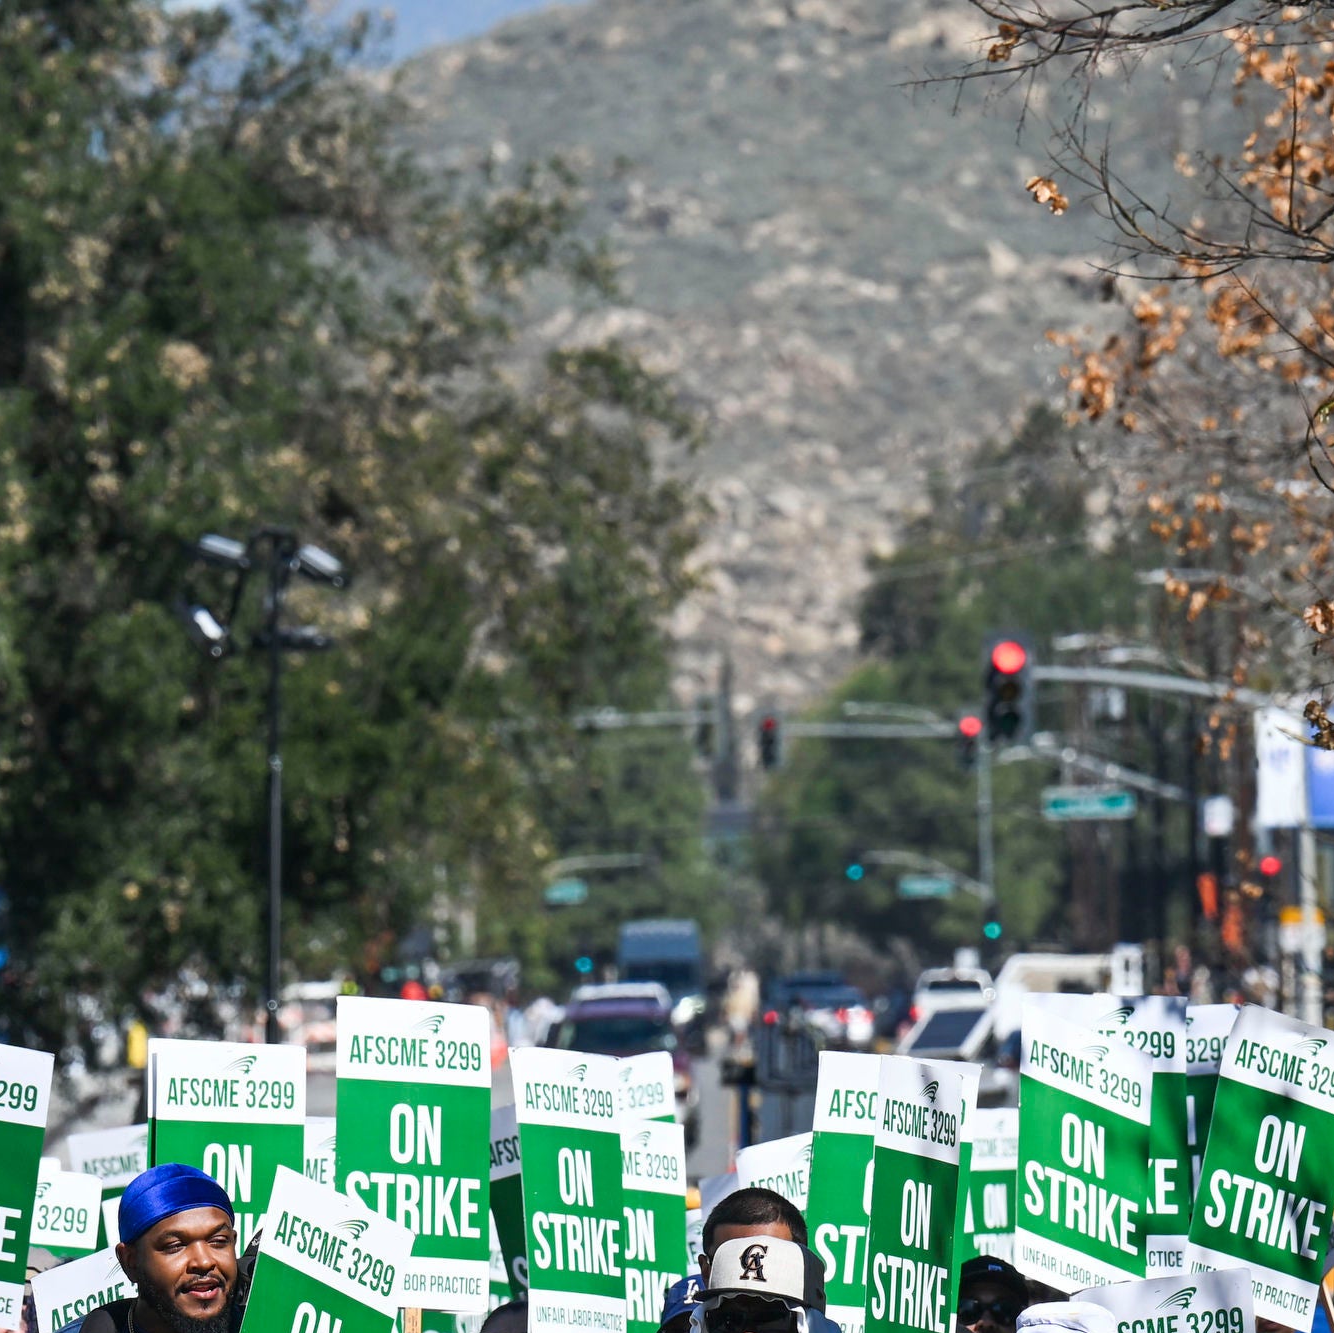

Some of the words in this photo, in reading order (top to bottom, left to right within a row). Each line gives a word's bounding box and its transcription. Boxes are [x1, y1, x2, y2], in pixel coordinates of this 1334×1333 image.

[349, 1034, 428, 1068] AFSCME
[435, 1040, 482, 1071] 3299
[1029, 1039, 1093, 1089] AFSCME
[1099, 1068, 1142, 1109] 3299
[1234, 1038, 1306, 1087] AFSCME
[167, 1077, 240, 1108] AFSCME
[245, 1080, 296, 1110] 3299
[525, 1082, 579, 1114] AFSCME
[582, 1088, 613, 1118] 3299
[627, 1082, 665, 1110] 3299
[828, 1088, 878, 1122] AFSC
[390, 1103, 442, 1166] ON
[883, 1099, 928, 1139] AFSCME
[931, 1111, 957, 1148] 3299
[489, 1136, 520, 1171] AFSC
[646, 1153, 679, 1182] 3299
[1060, 1112, 1106, 1180] ON
[1254, 1115, 1307, 1182] ON
[203, 1143, 252, 1203] ON
[557, 1147, 595, 1208] ON
[37, 1204, 88, 1234] 3299
[900, 1178, 932, 1251] ON
[1024, 1160, 1139, 1257] STRIKE
[1204, 1168, 1327, 1261] STRIKE
[273, 1210, 348, 1274] AFSCME
[347, 1249, 396, 1297] 3299
[532, 1211, 622, 1278] STRIKE
[1022, 1245, 1057, 1273] UNFAIR
[1060, 1257, 1091, 1284] LABOR
[1147, 1250, 1184, 1268] CTICE
[404, 1274, 428, 1292] BOR
[430, 1275, 482, 1296] PRACTICE
[1263, 1283, 1311, 1316] PRACTICE
[536, 1305, 565, 1324] UNFAIR
[568, 1308, 592, 1327] LABOR
[593, 1311, 623, 1333] PRACTICE
